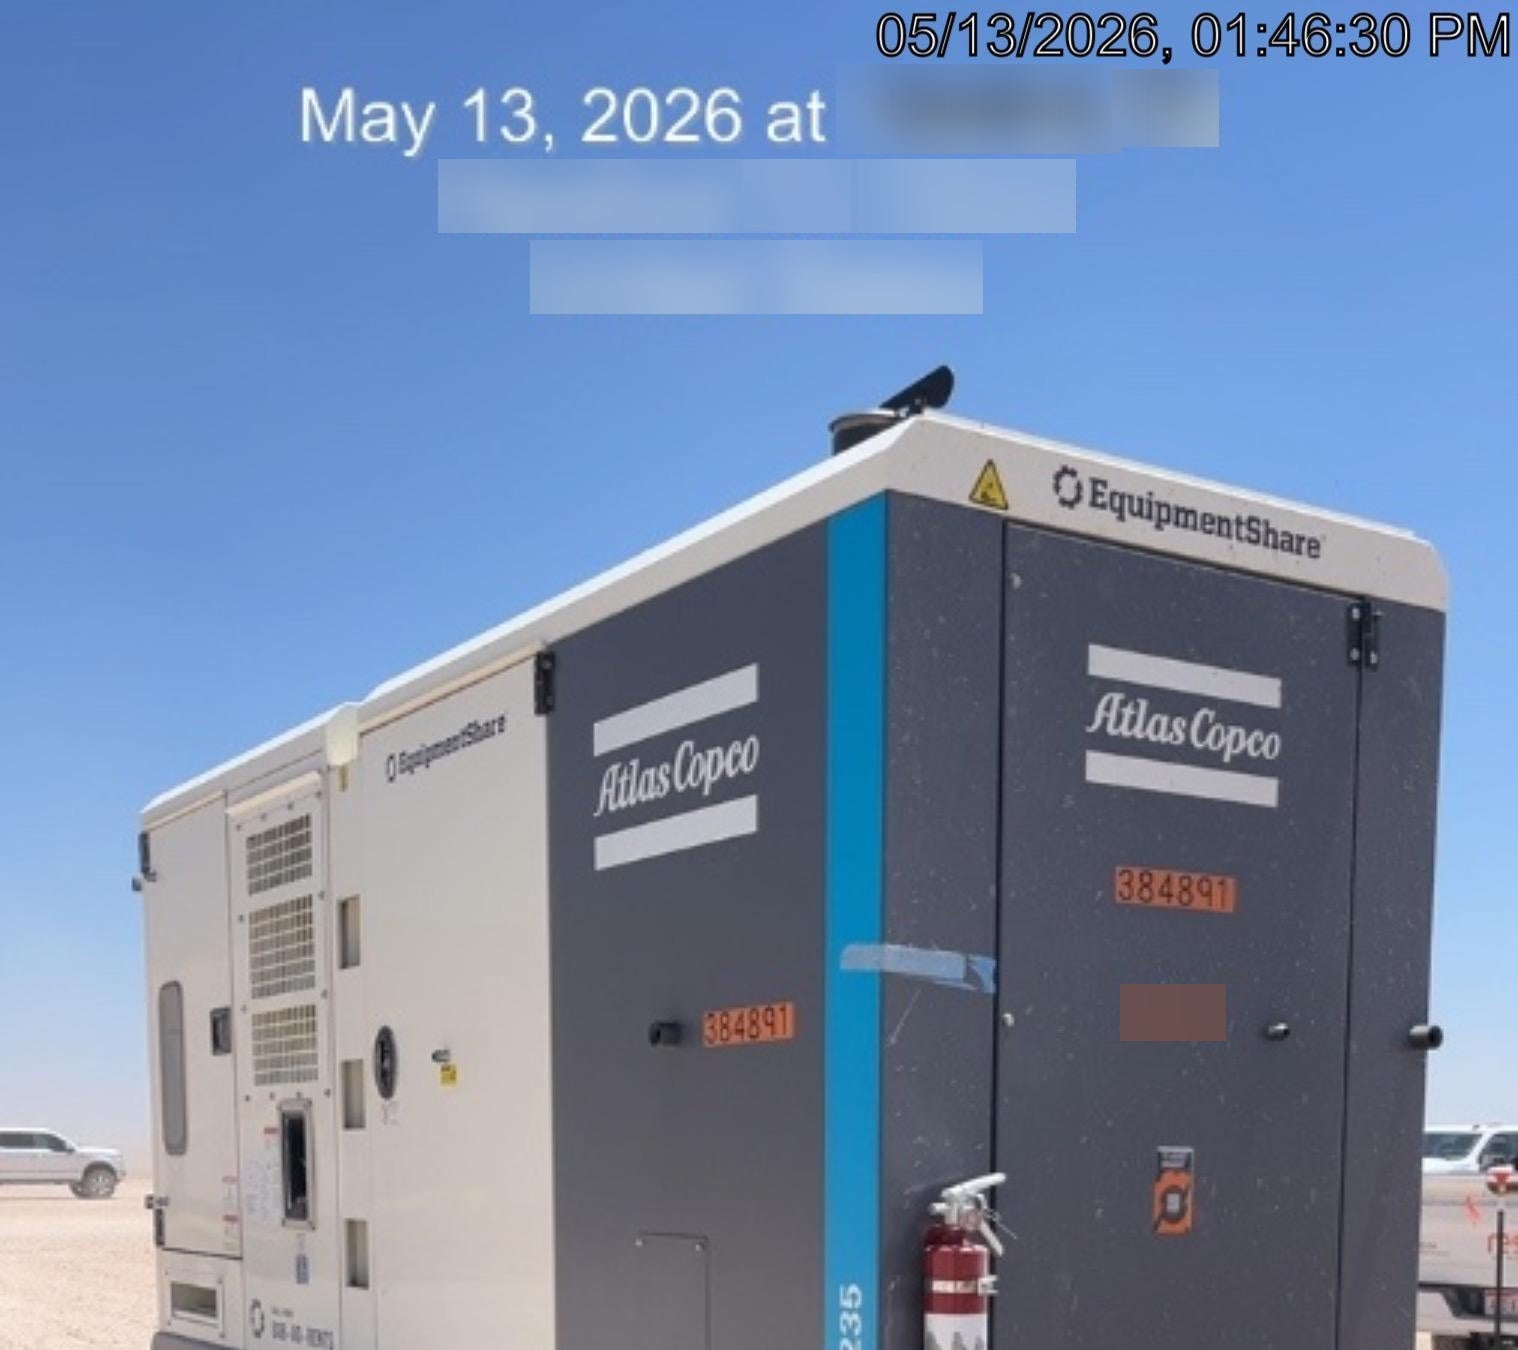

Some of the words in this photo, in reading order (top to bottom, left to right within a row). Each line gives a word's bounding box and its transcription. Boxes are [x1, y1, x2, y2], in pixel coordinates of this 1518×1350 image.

[1089, 477, 1321, 560] EquipmentShare
[399, 714, 506, 775] EquipmentShare
[1085, 692, 1188, 745] Atlas
[1190, 707, 1281, 763] Copco
[593, 758, 671, 817] Atlas
[673, 734, 760, 796] Copco
[1118, 869, 1226, 908] 384891
[703, 1003, 787, 1045] 384891
